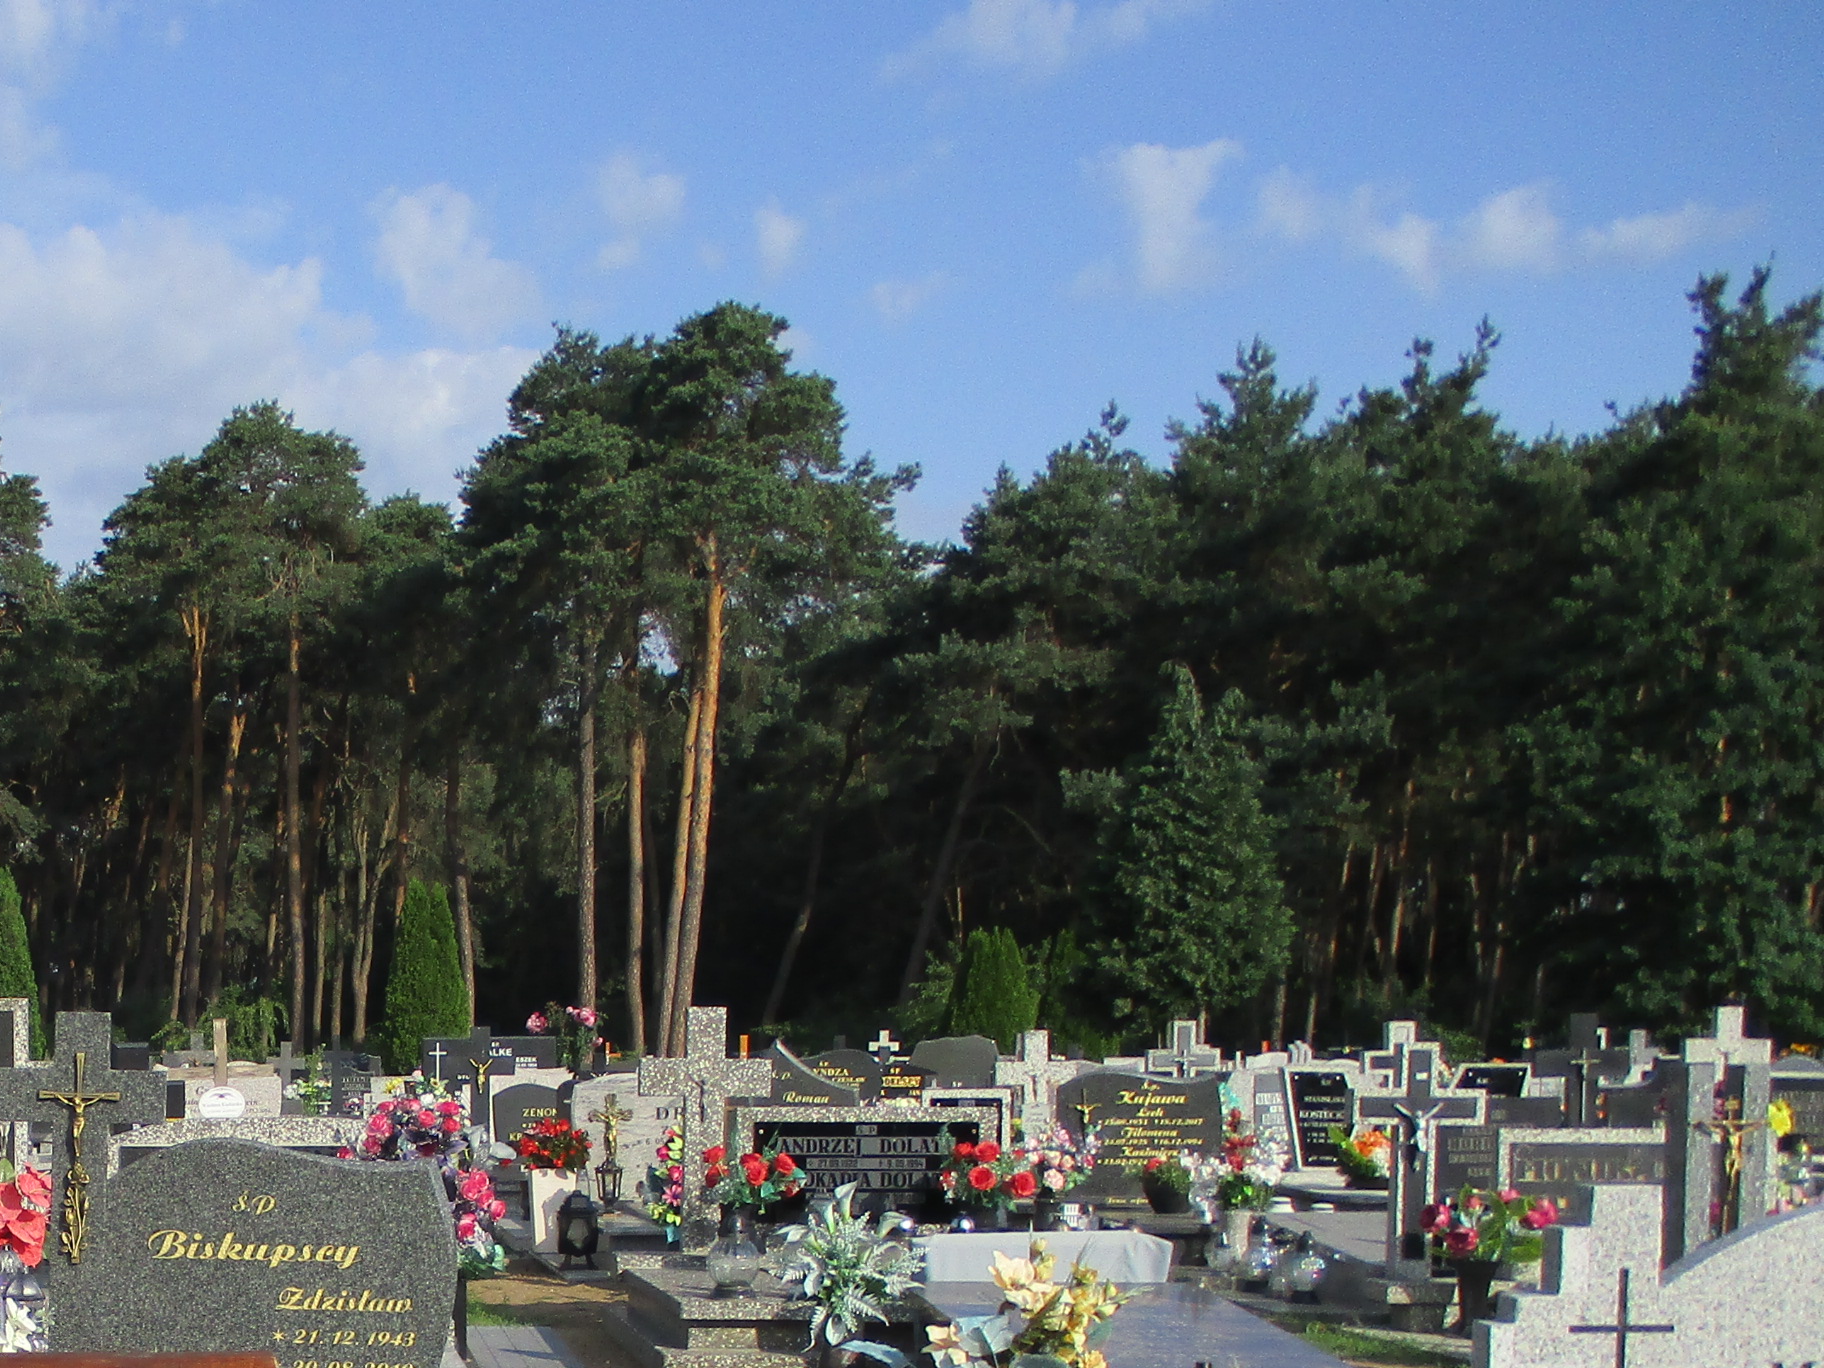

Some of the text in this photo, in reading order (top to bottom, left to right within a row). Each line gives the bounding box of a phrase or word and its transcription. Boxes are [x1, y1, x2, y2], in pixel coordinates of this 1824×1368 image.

[782, 1090, 830, 1104] Roman
[1116, 1090, 1187, 1106] Kujawa
[1121, 1126, 1178, 1138] Filomena
[780, 1137, 862, 1156] ANDRZEJ
[147, 1229, 360, 1269] Biskupscy
[276, 1286, 413, 1314] Zdzisław
[367, 1330, 416, 1347] 1943
